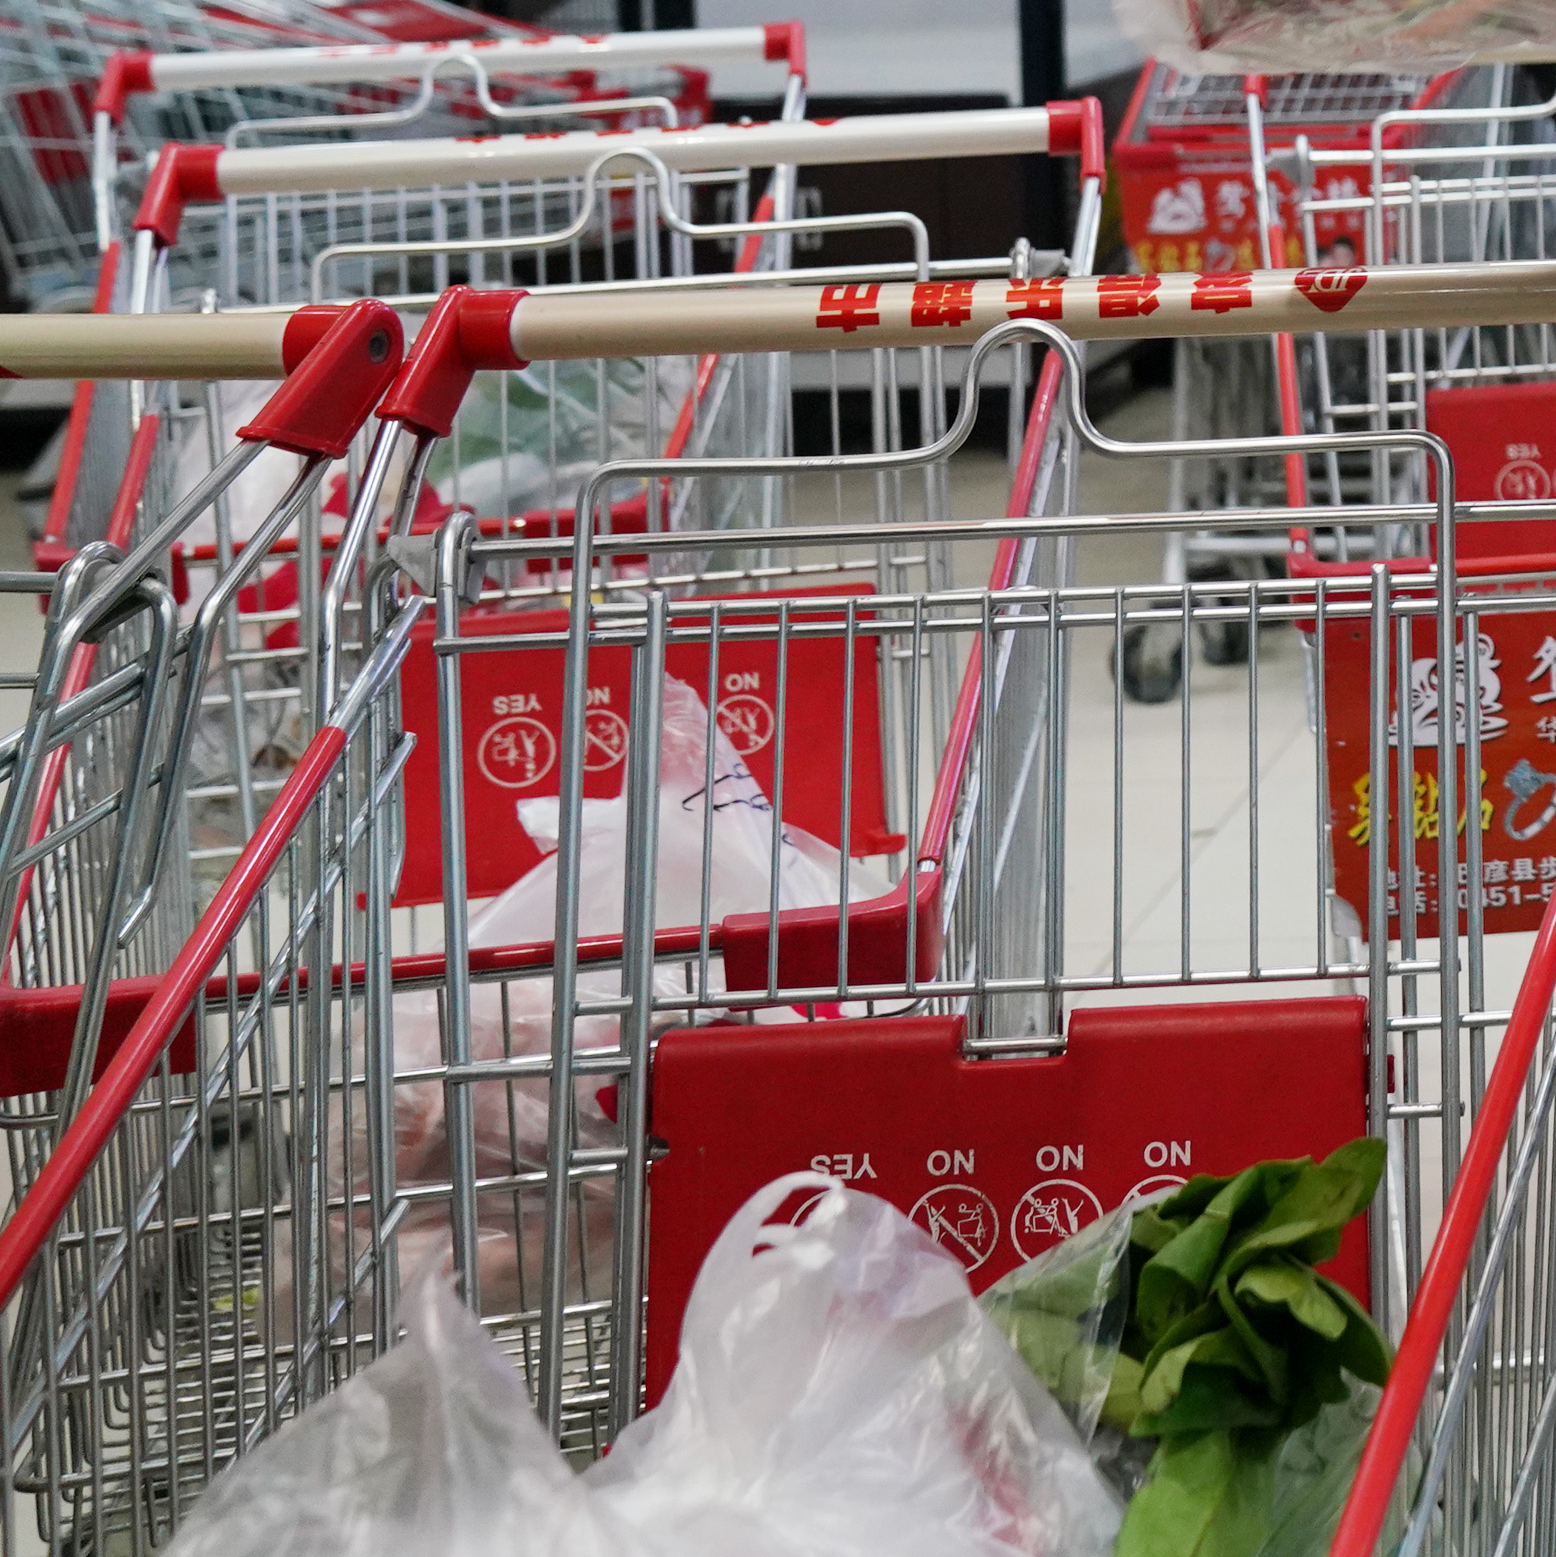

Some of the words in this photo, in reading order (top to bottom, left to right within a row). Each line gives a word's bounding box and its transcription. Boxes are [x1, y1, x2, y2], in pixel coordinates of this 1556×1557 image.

[725, 672, 760, 692] NO
[493, 693, 541, 715] YES
[810, 1152, 878, 1180] YES
[926, 1149, 976, 1177] NO
[1035, 1144, 1085, 1173] NO
[1143, 1140, 1192, 1168] NO
